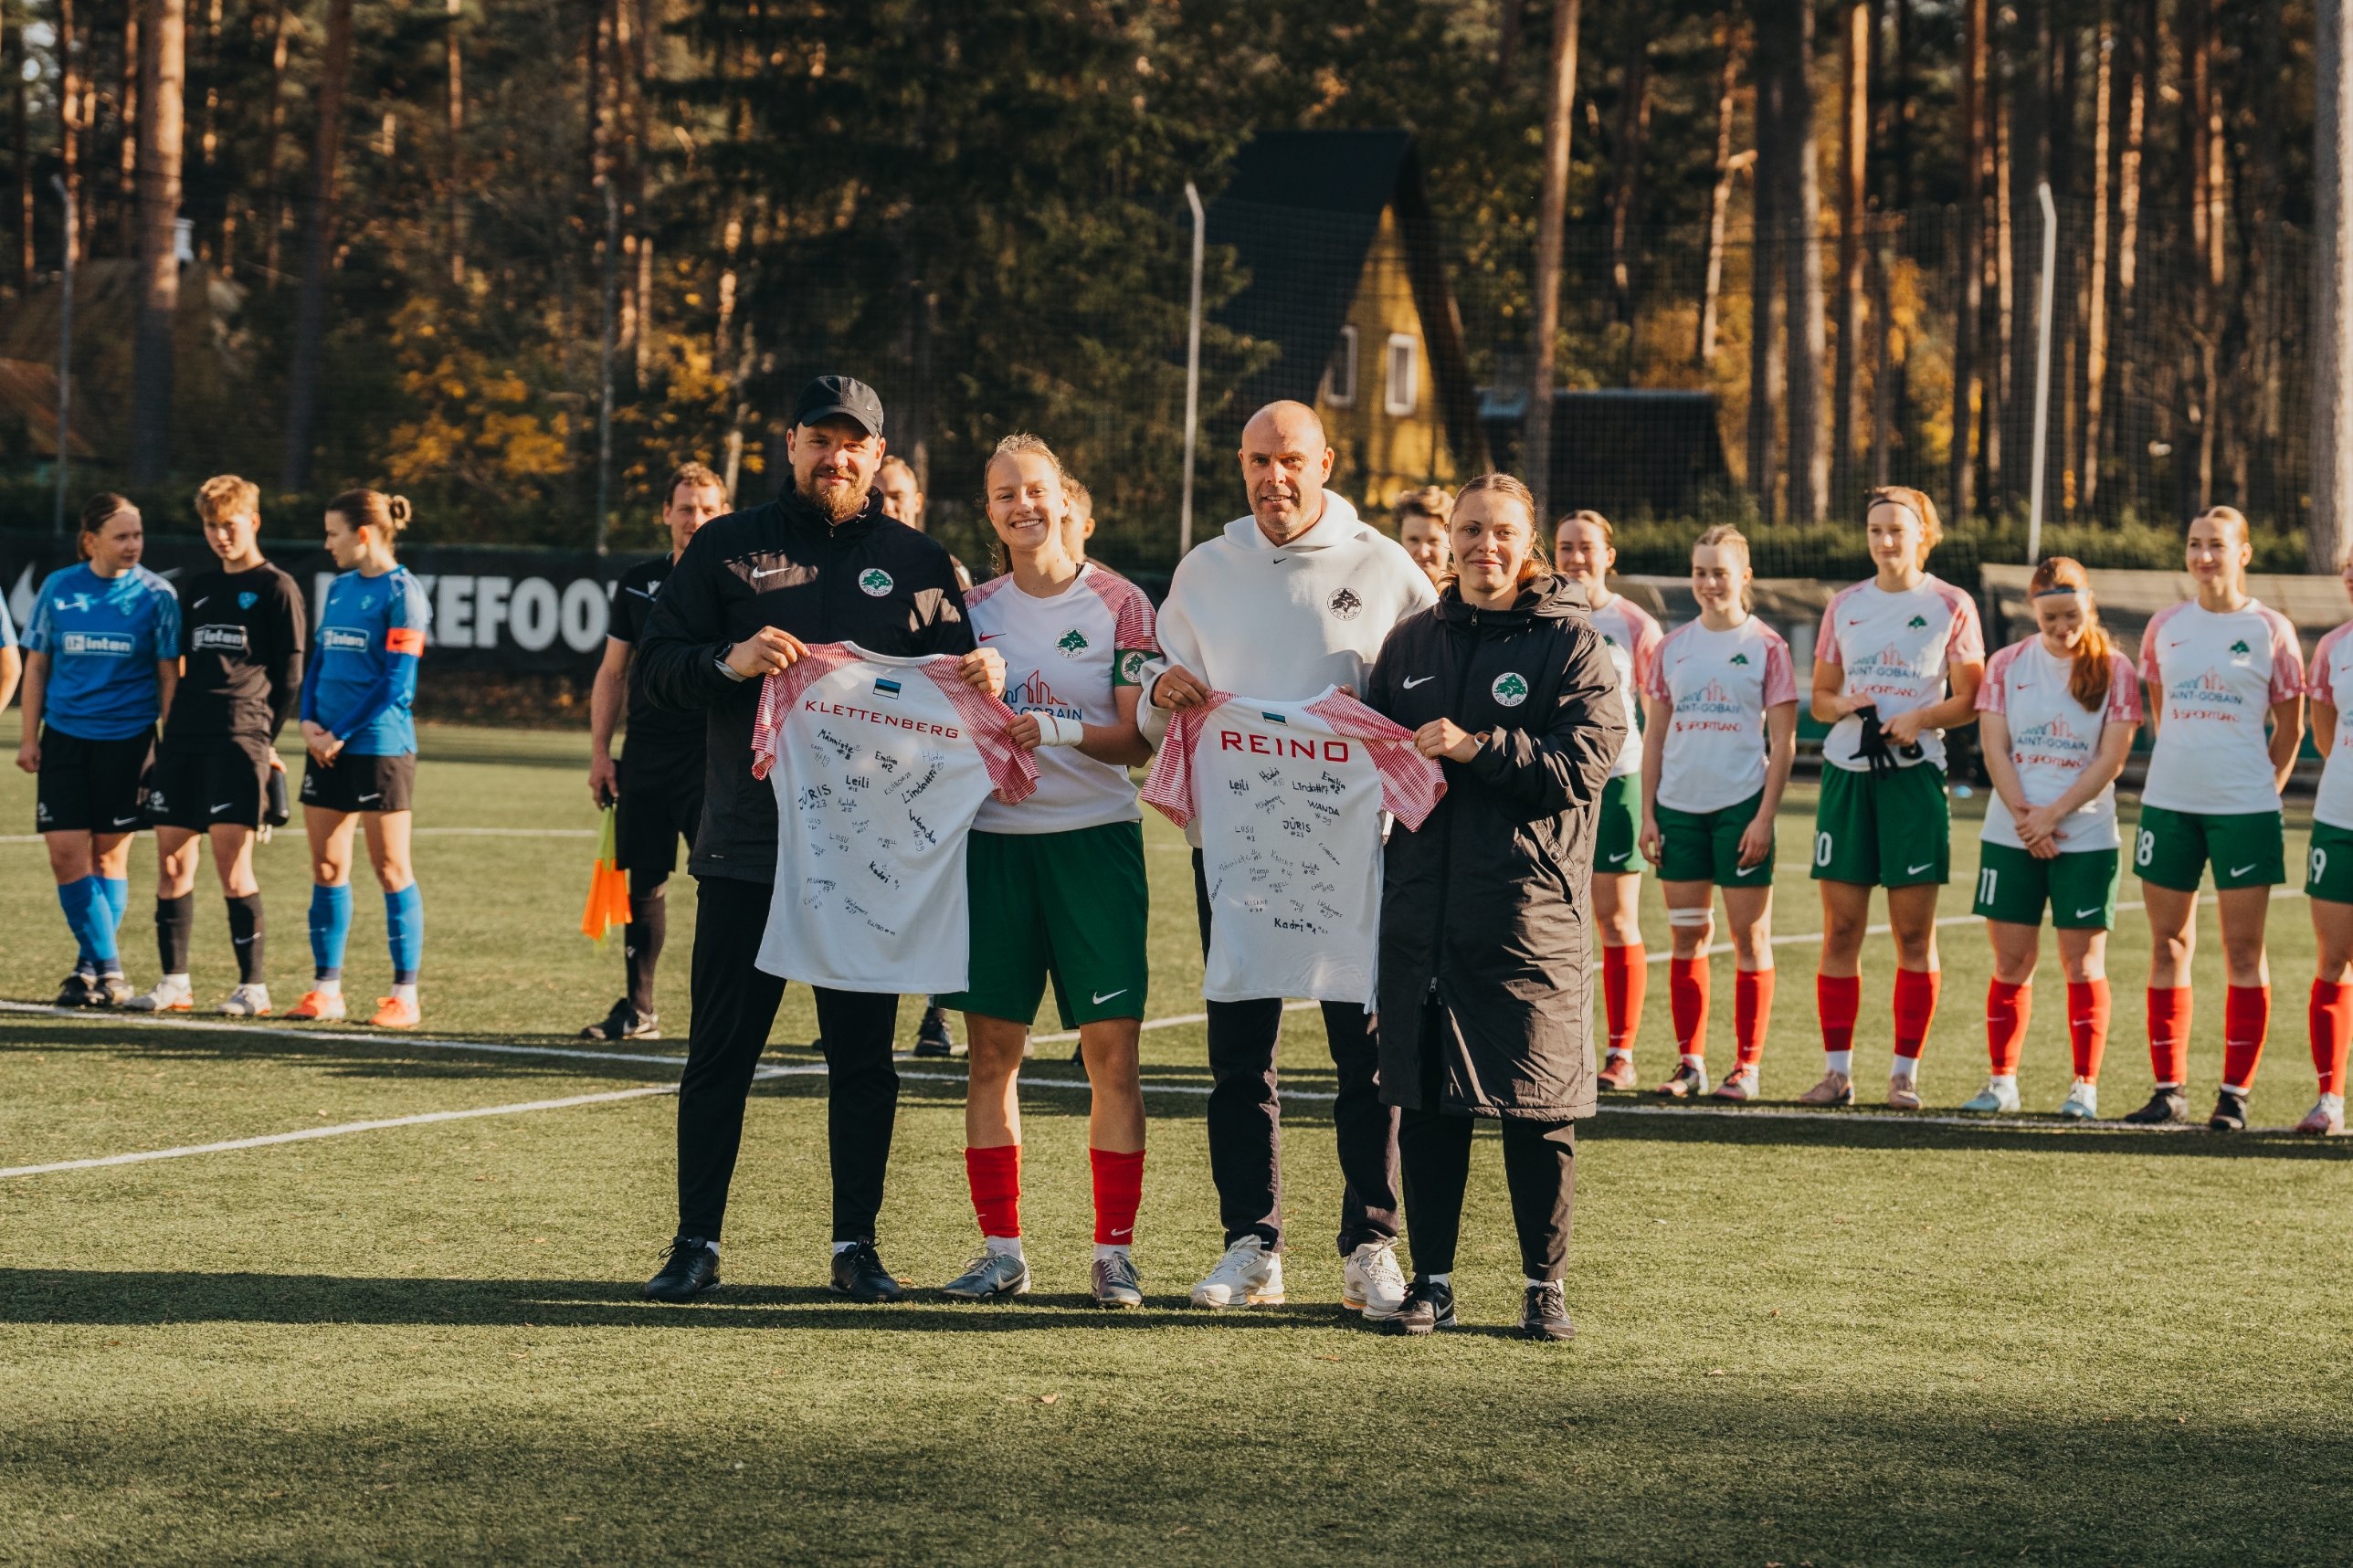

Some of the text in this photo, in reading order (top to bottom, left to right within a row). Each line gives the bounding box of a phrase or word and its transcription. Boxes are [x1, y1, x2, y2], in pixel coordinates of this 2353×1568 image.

[805, 700, 959, 739] KLETTENBERG
[1220, 730, 1349, 763] REINO
[846, 774, 870, 789] Leili
[1229, 778, 1249, 791] Leili
[1307, 799, 1341, 817] WANDA
[1978, 867, 1999, 907] 11
[1274, 917, 1303, 932] Kadri
